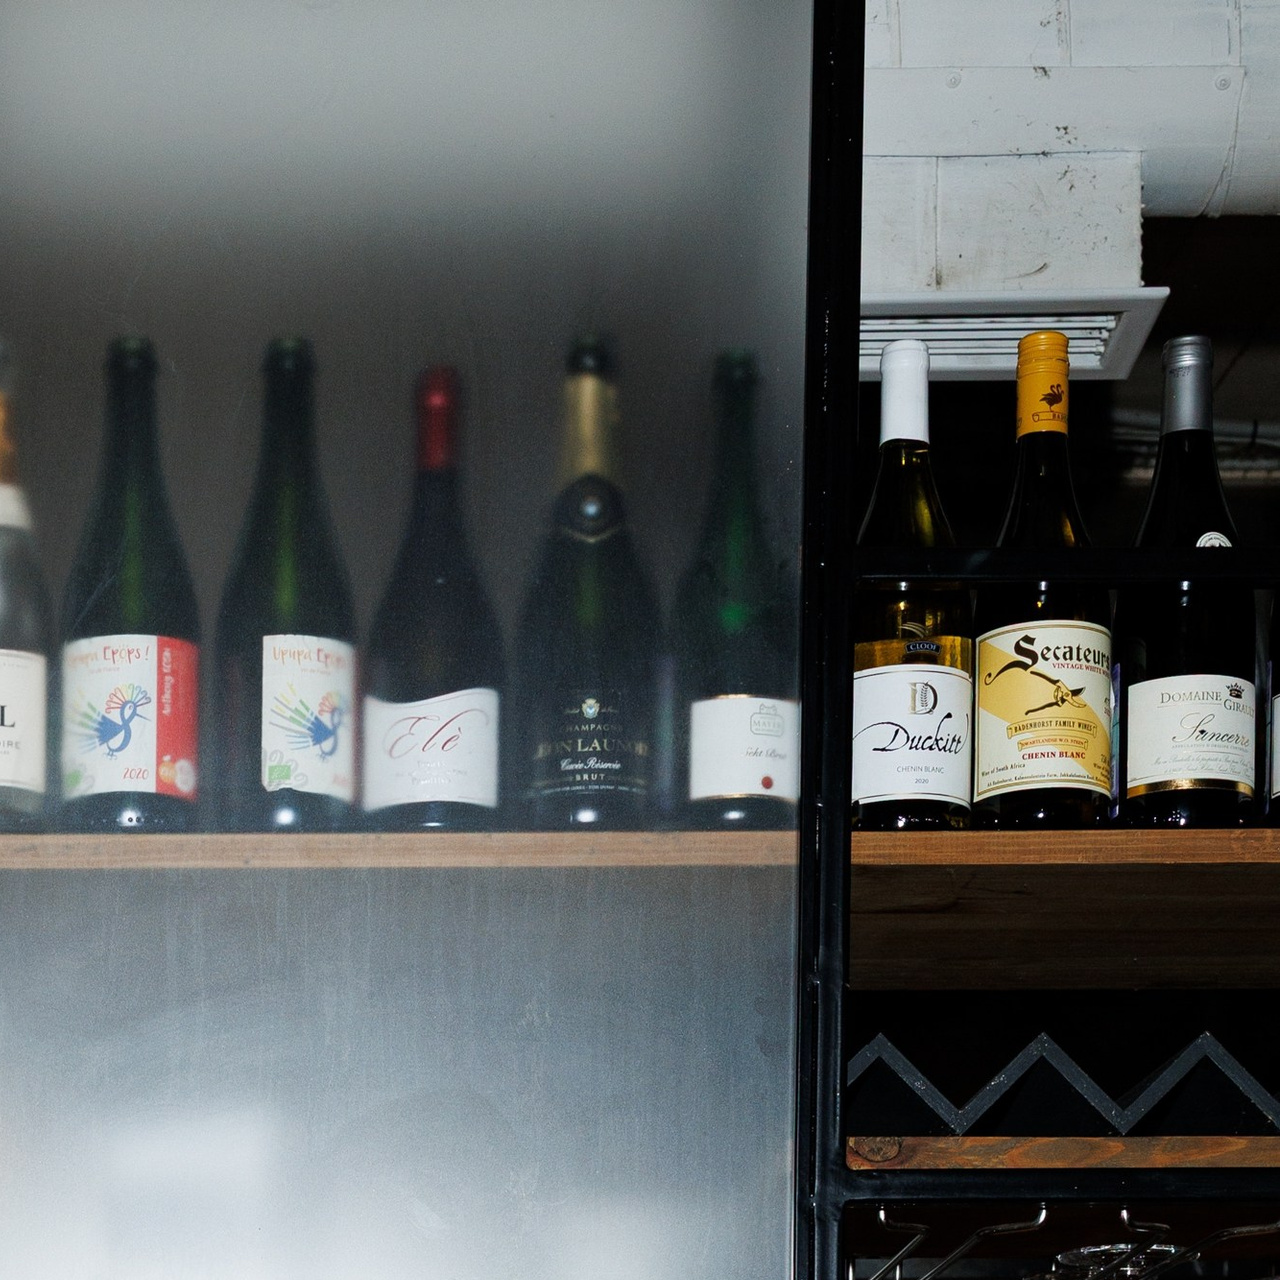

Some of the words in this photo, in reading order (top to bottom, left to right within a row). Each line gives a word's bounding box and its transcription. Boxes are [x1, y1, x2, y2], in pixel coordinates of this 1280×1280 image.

[1052, 662, 1083, 671] VINTAGE
[1085, 664, 1101, 675] WHITE
[1160, 691, 1222, 705] DOMAINE
[1055, 720, 1075, 728] FAMILY
[1077, 721, 1093, 732] WINES
[1021, 751, 1056, 760] CHENIN
[1058, 750, 1086, 760] BLANC
[123, 767, 150, 780] 2020
[896, 764, 923, 773] CHENIN
[924, 764, 945, 774] BLANC
[575, 773, 606, 781] BRUT
